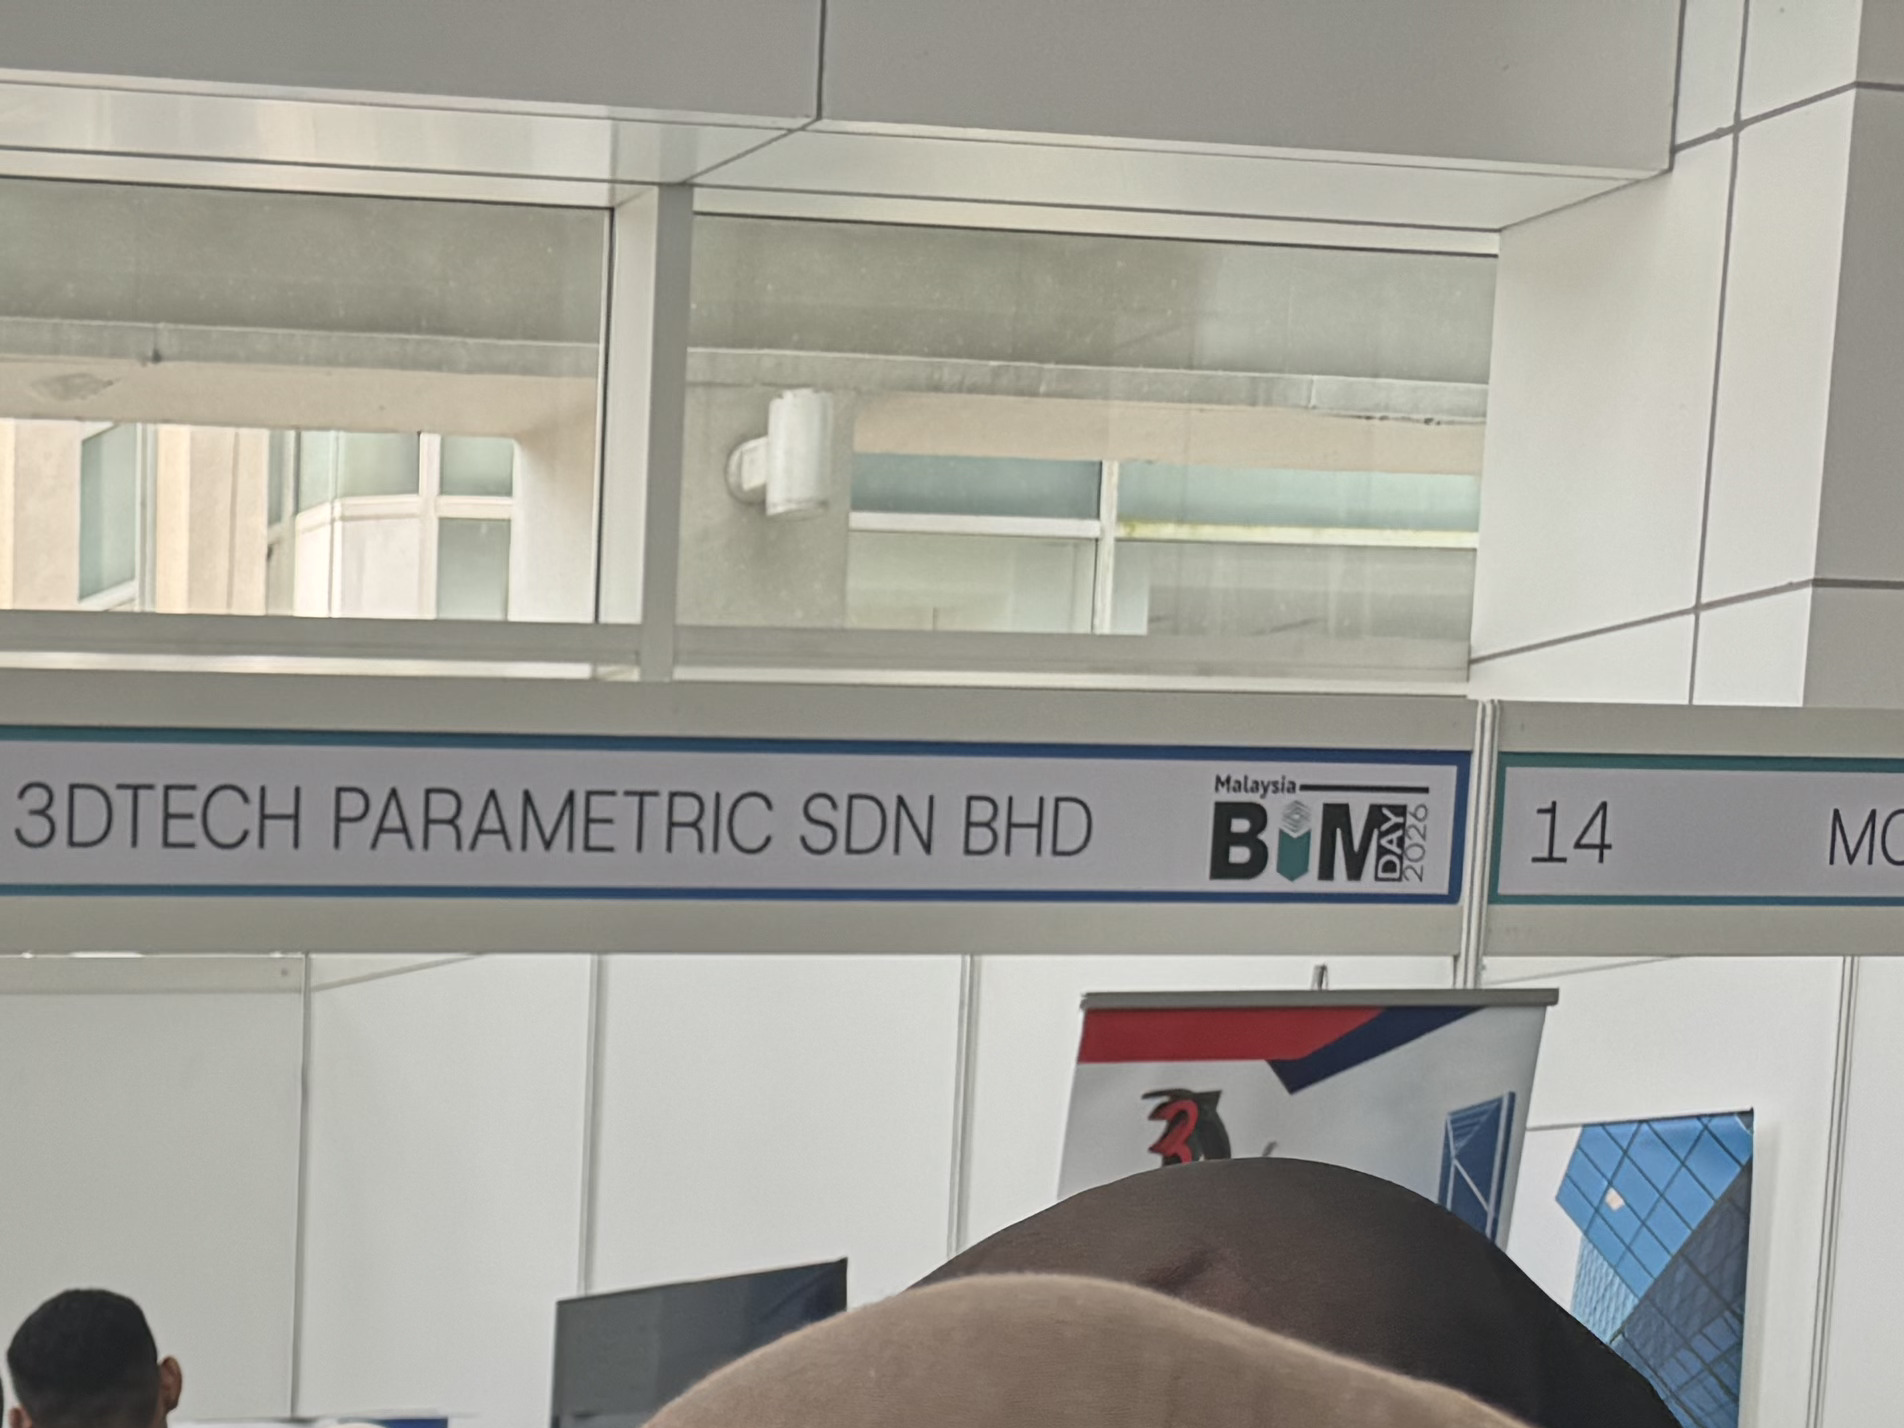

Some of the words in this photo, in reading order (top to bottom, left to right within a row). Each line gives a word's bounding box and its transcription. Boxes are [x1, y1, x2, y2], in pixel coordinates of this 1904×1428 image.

[14, 781, 301, 850] 3DTECH
[333, 785, 774, 855] PARAMETRIC
[799, 792, 934, 856] SDN
[963, 794, 1093, 857] BHD
[1214, 774, 1297, 799] Malaysia
[1377, 806, 1406, 880] DAY
[1403, 802, 1429, 883] 2026
[1531, 800, 1612, 864] 14
